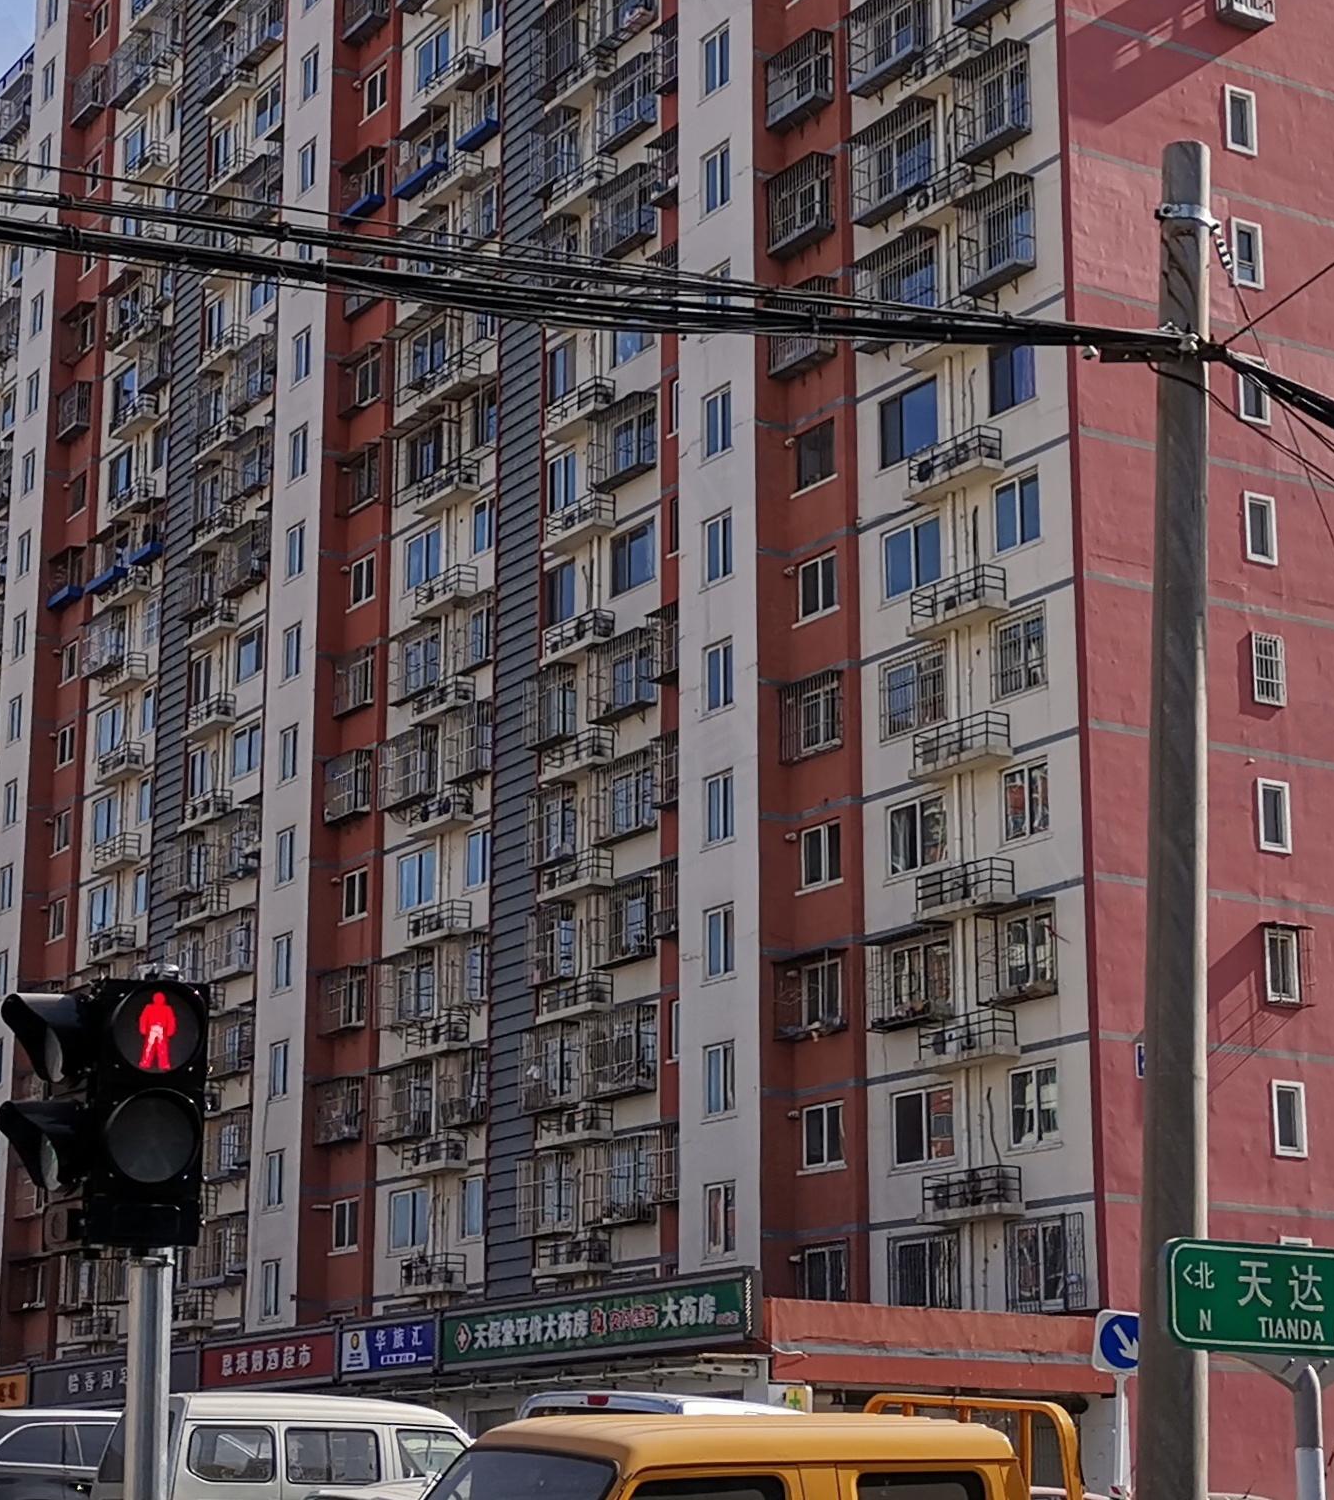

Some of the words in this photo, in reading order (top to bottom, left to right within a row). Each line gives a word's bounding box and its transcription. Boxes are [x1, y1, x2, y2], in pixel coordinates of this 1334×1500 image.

[1193, 1260, 1216, 1291] 北
[1199, 1307, 1212, 1333] N
[1257, 1316, 1325, 1343] TIANDA
